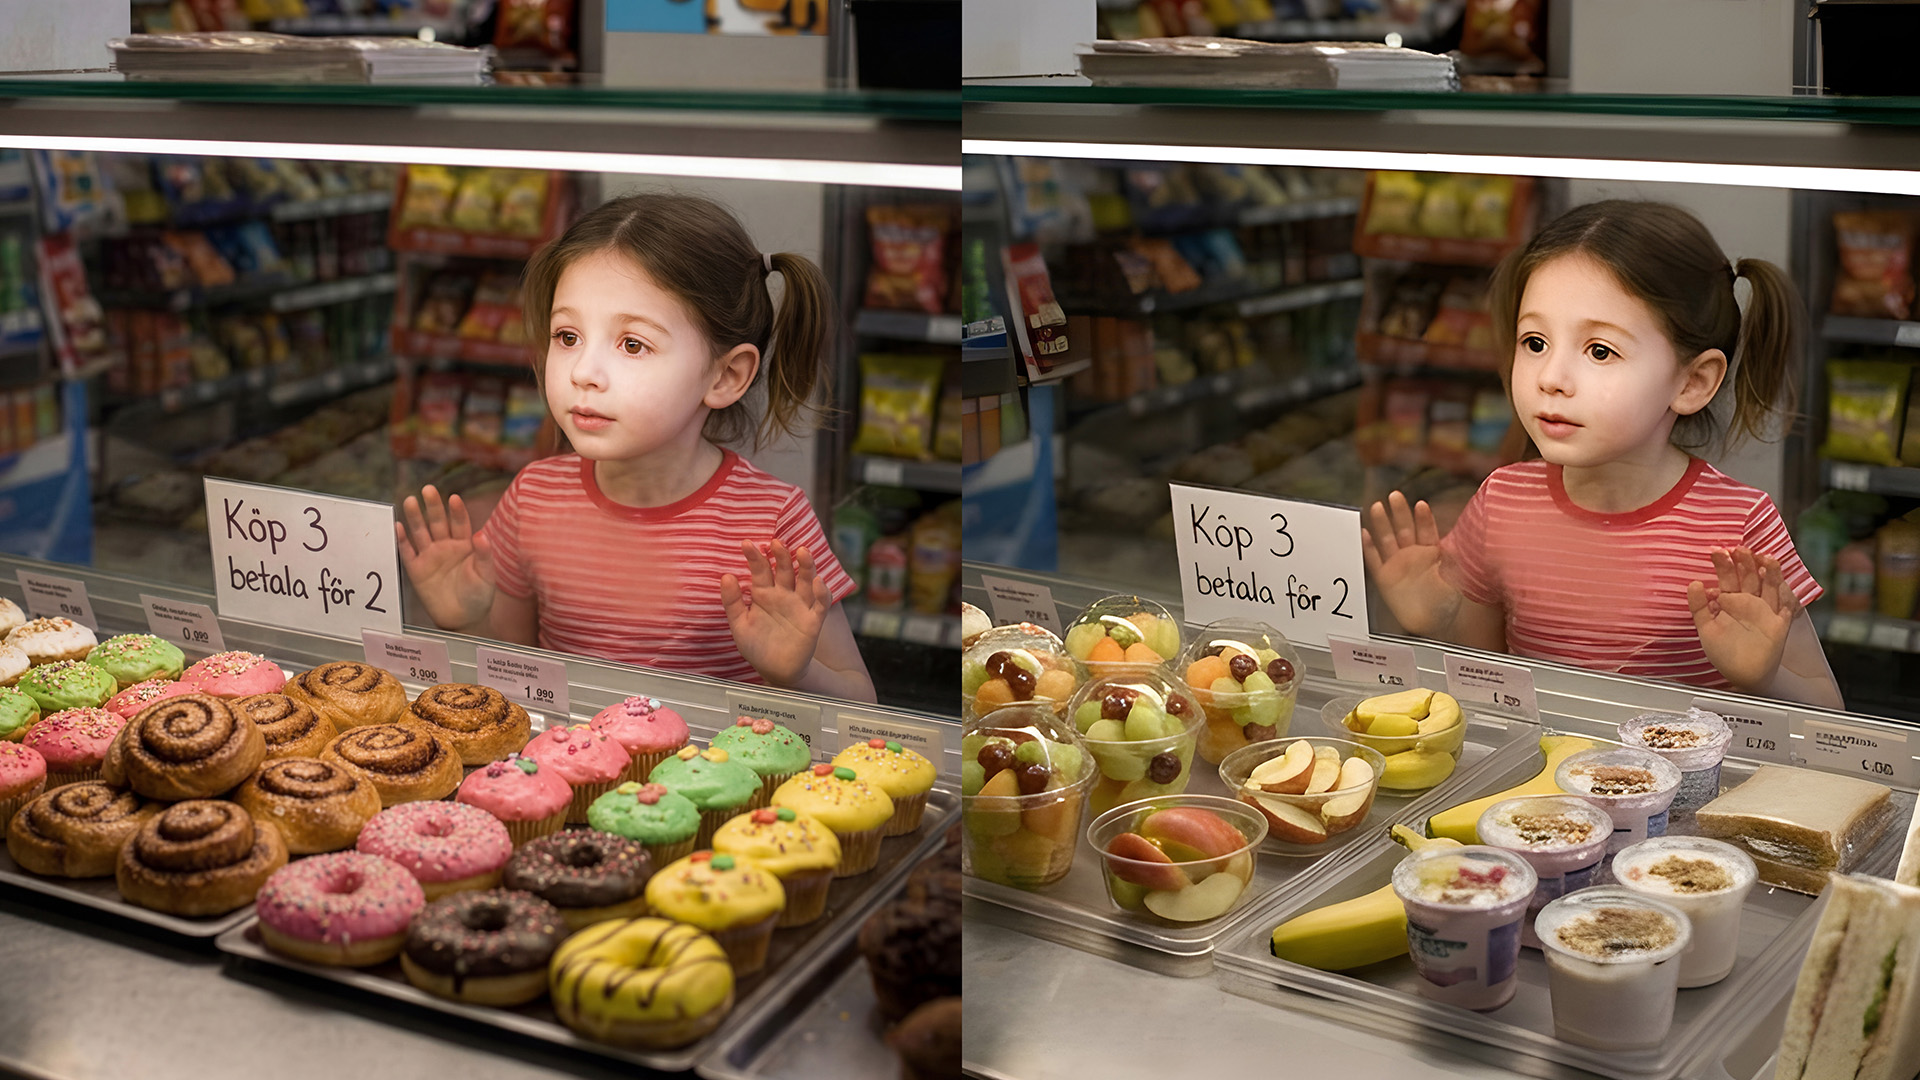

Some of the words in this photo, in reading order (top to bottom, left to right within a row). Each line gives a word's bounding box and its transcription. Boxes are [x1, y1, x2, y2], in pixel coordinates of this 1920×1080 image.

[224, 498, 287, 554] Köp
[303, 506, 328, 552] 3
[1270, 513, 1294, 557] 3
[228, 555, 309, 599] betala
[318, 567, 355, 614] för
[365, 571, 387, 613] 2
[1195, 562, 1275, 605] betala
[1331, 577, 1353, 619] 2
